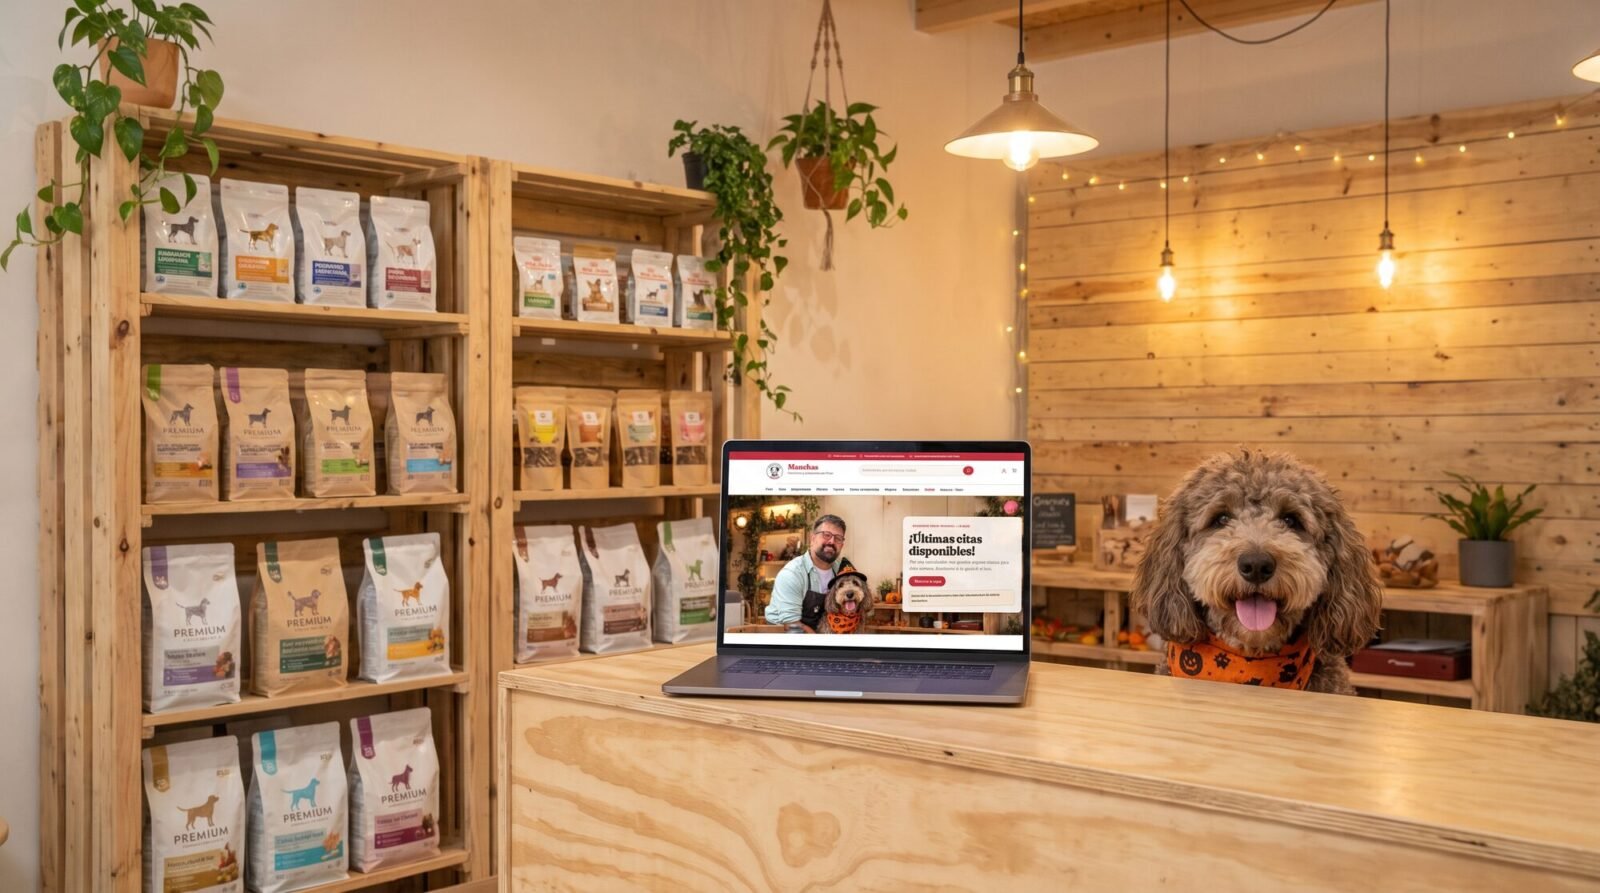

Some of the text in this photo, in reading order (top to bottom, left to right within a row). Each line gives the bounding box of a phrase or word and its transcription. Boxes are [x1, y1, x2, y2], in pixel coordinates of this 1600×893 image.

[787, 463, 819, 471] Manchas
[909, 531, 983, 545] ¡Últimas citas
[909, 546, 976, 558] disponibles!
[534, 593, 572, 603] PREMIUM
[609, 587, 642, 597] PREMIUM
[394, 605, 438, 617] PREMIUM
[287, 616, 332, 628] PREMIUM
[173, 624, 226, 638] PREMIUM
[381, 788, 427, 804] PREMIUM
[283, 806, 333, 824] PREMIUM
[173, 826, 229, 845] PREMIUM
